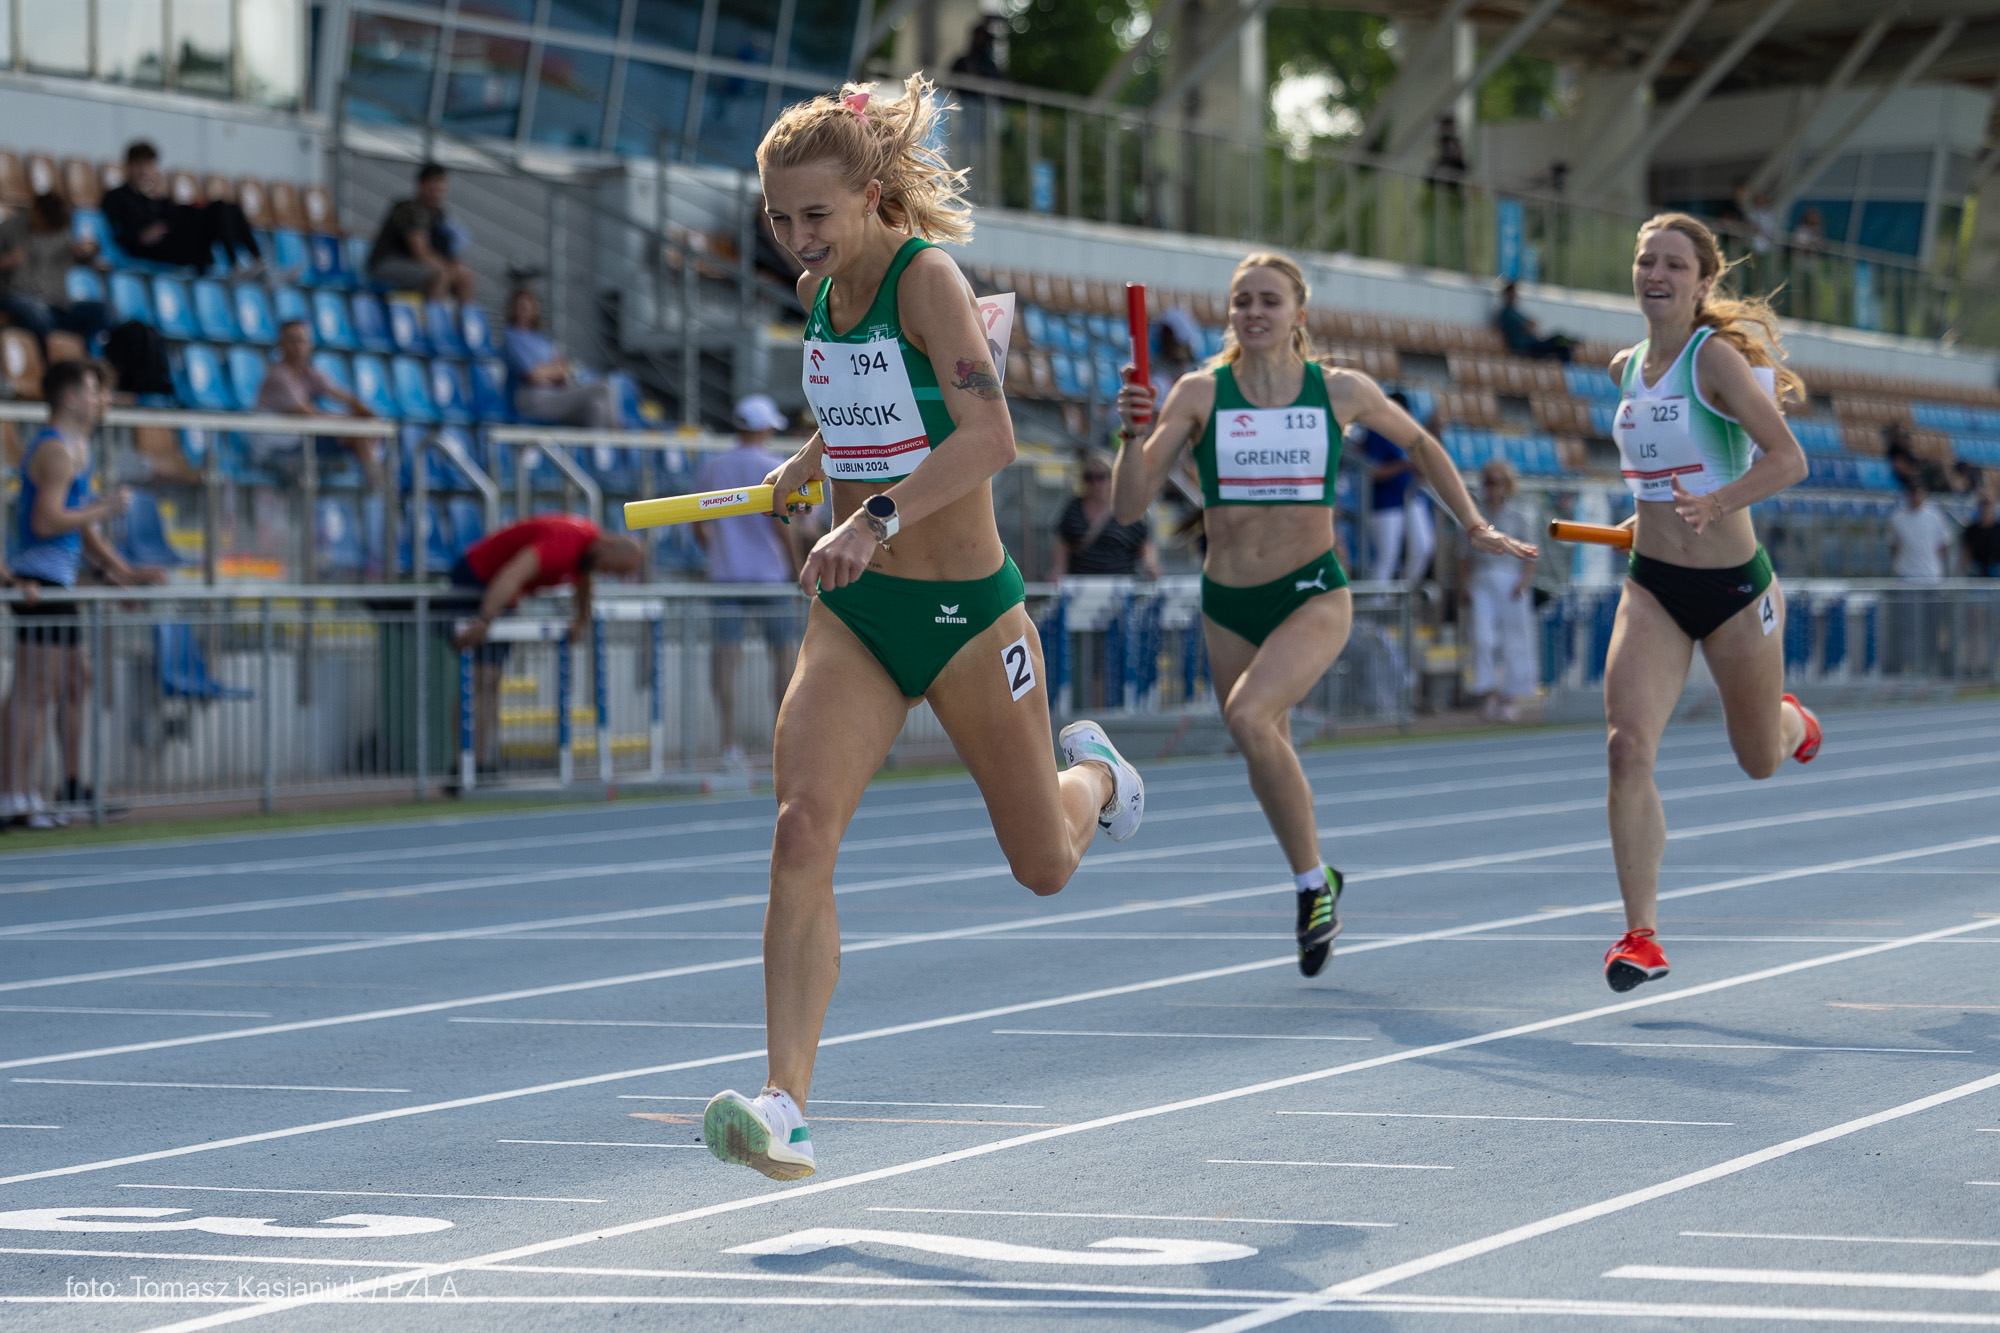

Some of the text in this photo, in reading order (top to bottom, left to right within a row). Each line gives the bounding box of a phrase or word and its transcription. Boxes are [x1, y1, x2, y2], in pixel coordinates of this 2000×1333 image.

[850, 351, 888, 376] 194
[809, 375, 829, 385] ORLEN
[815, 403, 902, 427] AGUŚCIK
[1285, 414, 1316, 429] 113
[1651, 406, 1679, 422] 225
[888, 440, 924, 453] MIESZANYCH
[1639, 444, 1658, 459] LIS
[1235, 450, 1311, 466] GREINER
[835, 461, 889, 473] LUBLIN 2024
[703, 495, 733, 506] polanik
[1763, 595, 1773, 624] 4
[935, 615, 967, 624] erima
[1006, 645, 1031, 692] 2
[719, 1228, 1259, 1266] 2
